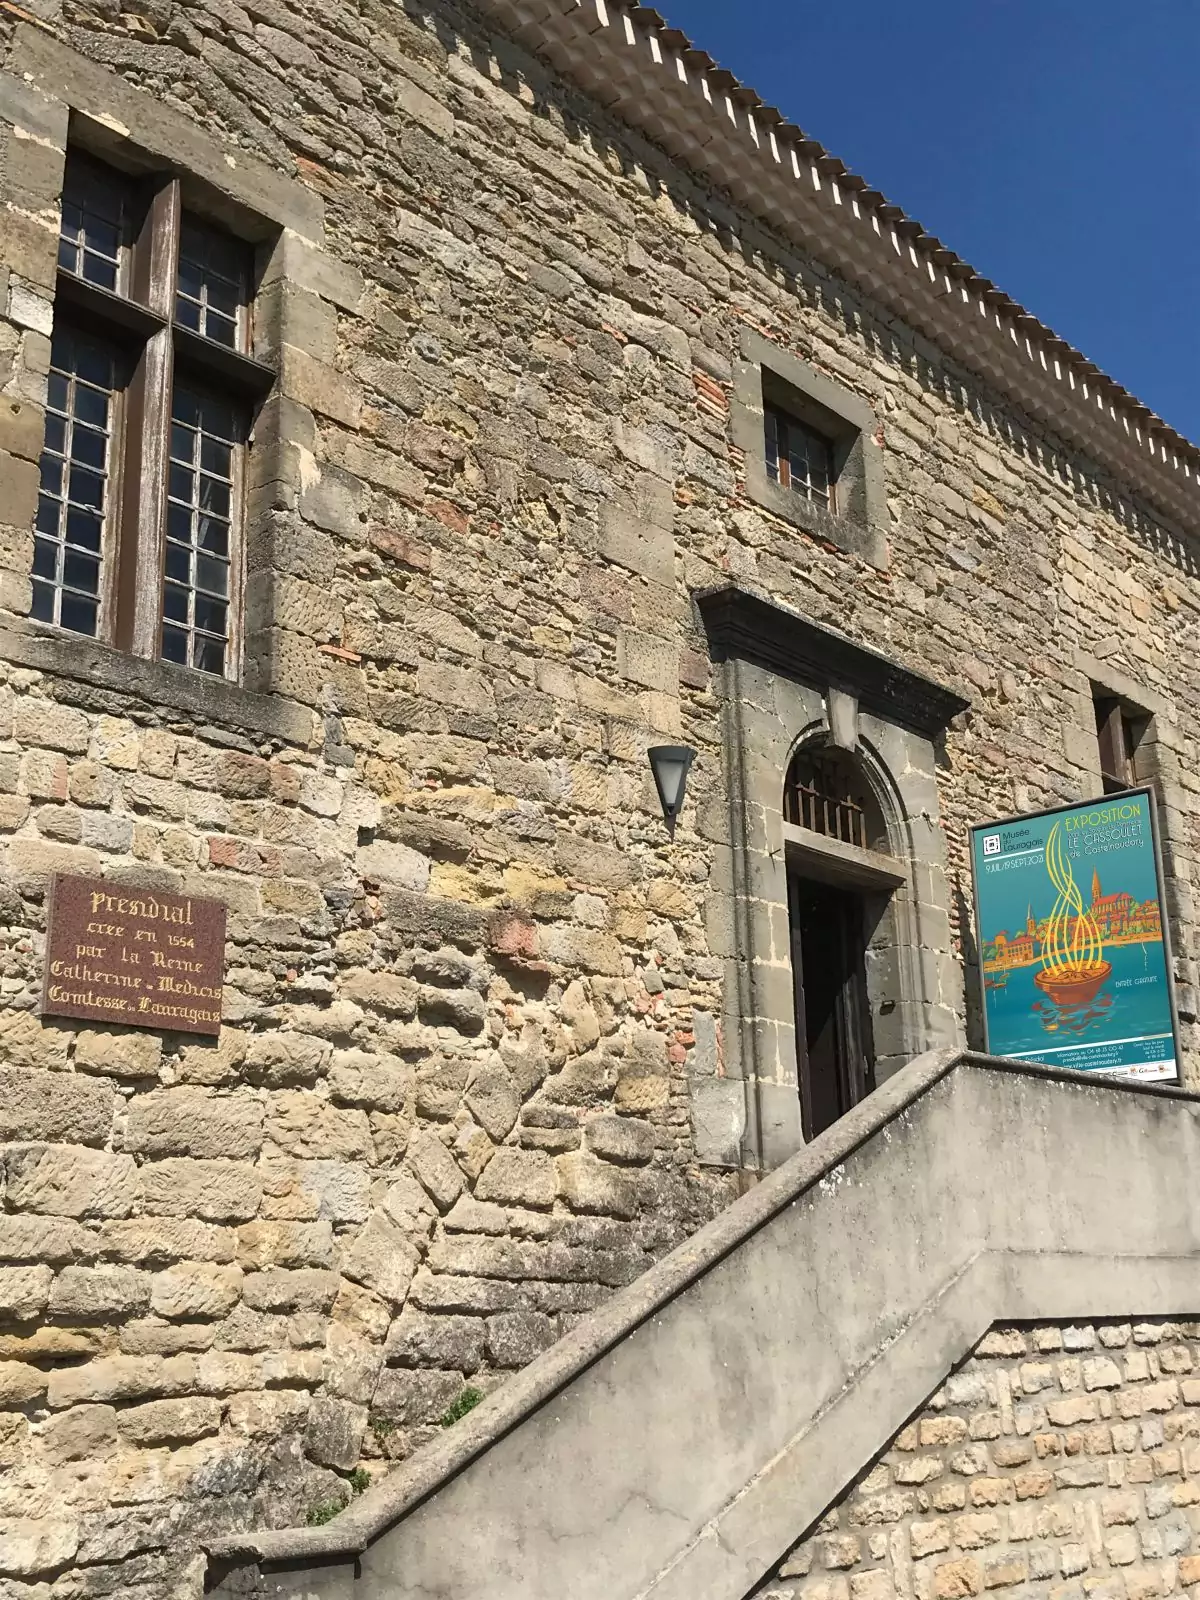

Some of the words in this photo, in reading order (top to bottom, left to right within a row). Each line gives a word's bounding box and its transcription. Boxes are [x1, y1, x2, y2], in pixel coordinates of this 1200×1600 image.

[1065, 804, 1141, 831] EXPOSITION
[1002, 829, 1030, 840] Musée
[1003, 838, 1044, 852] Lauragais
[1068, 837, 1080, 849] LE
[1083, 824, 1142, 845] CASSOULET
[1070, 850, 1081, 859] de
[1084, 839, 1144, 855] Castelnaudary
[134, 929, 157, 943] en
[168, 935, 195, 949] 1554
[75, 944, 106, 959] par
[121, 946, 140, 964] la
[150, 950, 204, 973] Reine
[50, 960, 142, 988] Catherine
[157, 975, 222, 1000] Medicis
[48, 984, 128, 1010] Comtesse
[137, 996, 221, 1025] Lauragais
